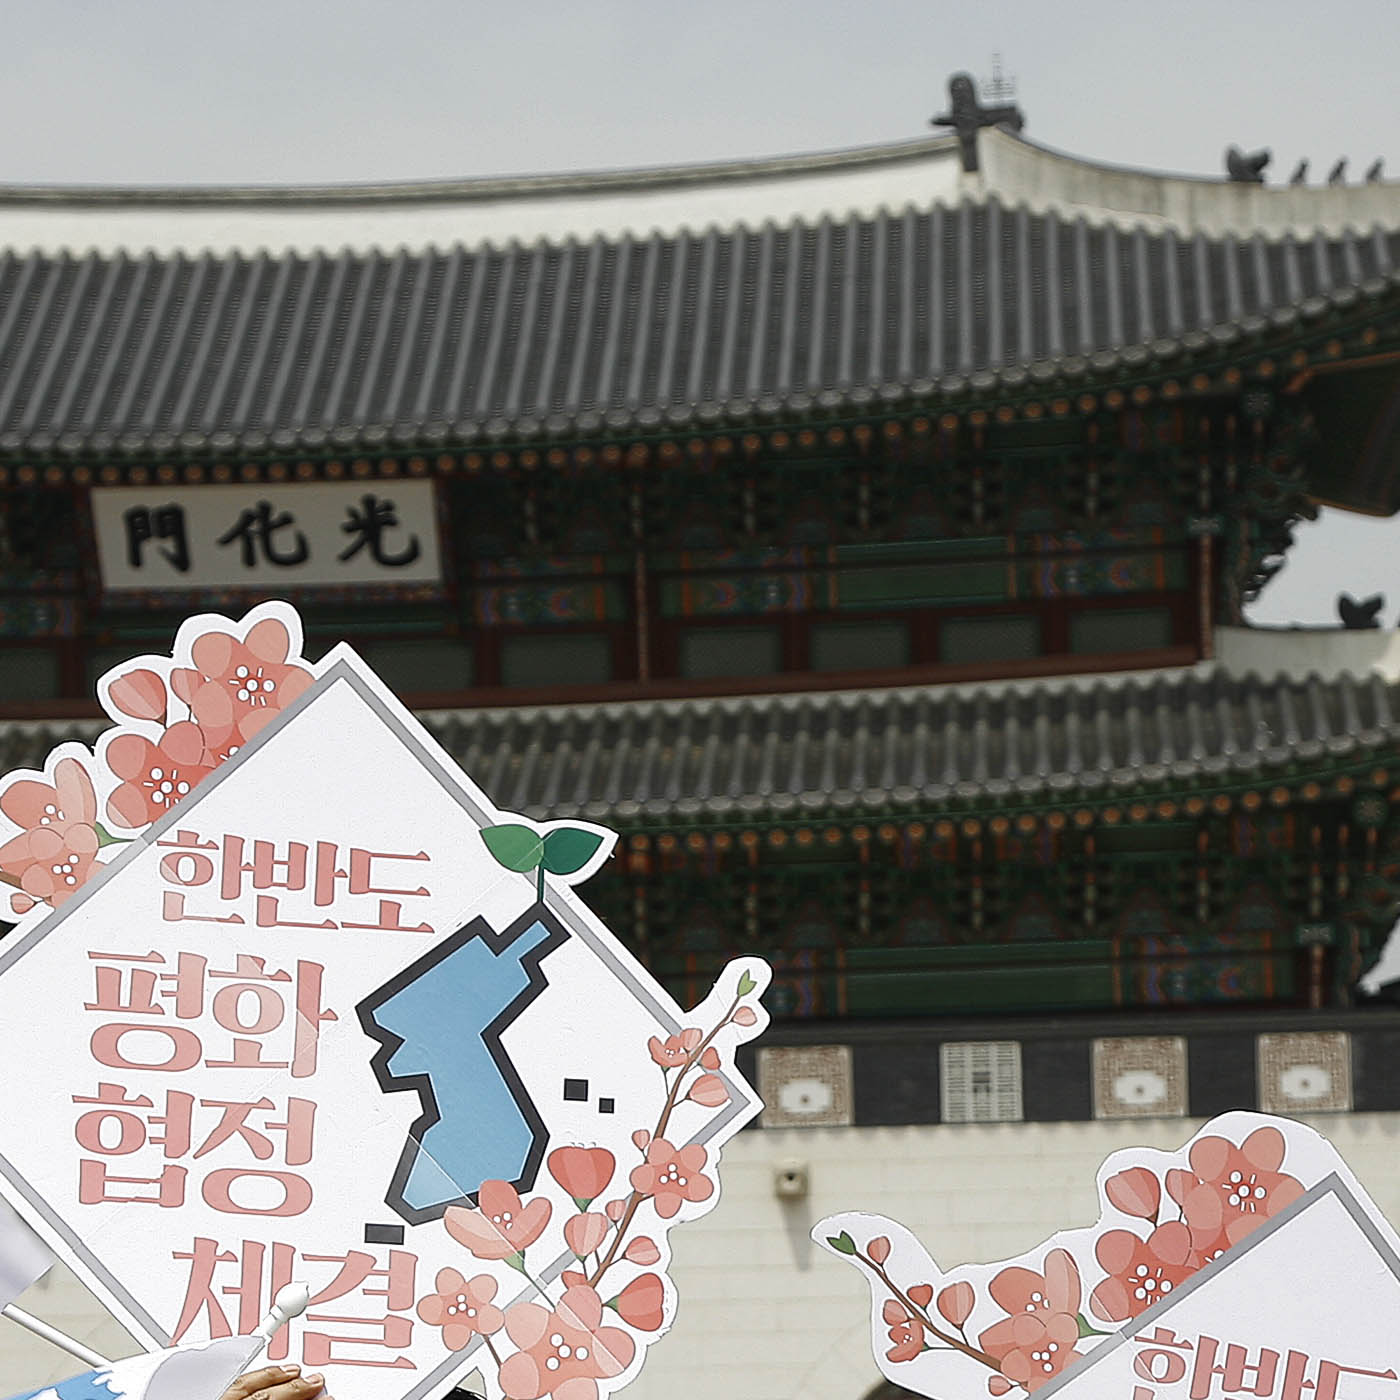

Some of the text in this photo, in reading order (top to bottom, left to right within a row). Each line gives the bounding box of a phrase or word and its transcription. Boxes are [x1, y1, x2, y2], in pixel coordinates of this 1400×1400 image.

[157, 830, 435, 934] 한반도
[84, 950, 338, 1078] 평화
[72, 1083, 314, 1217] 협정
[170, 1237, 418, 1370] 체결
